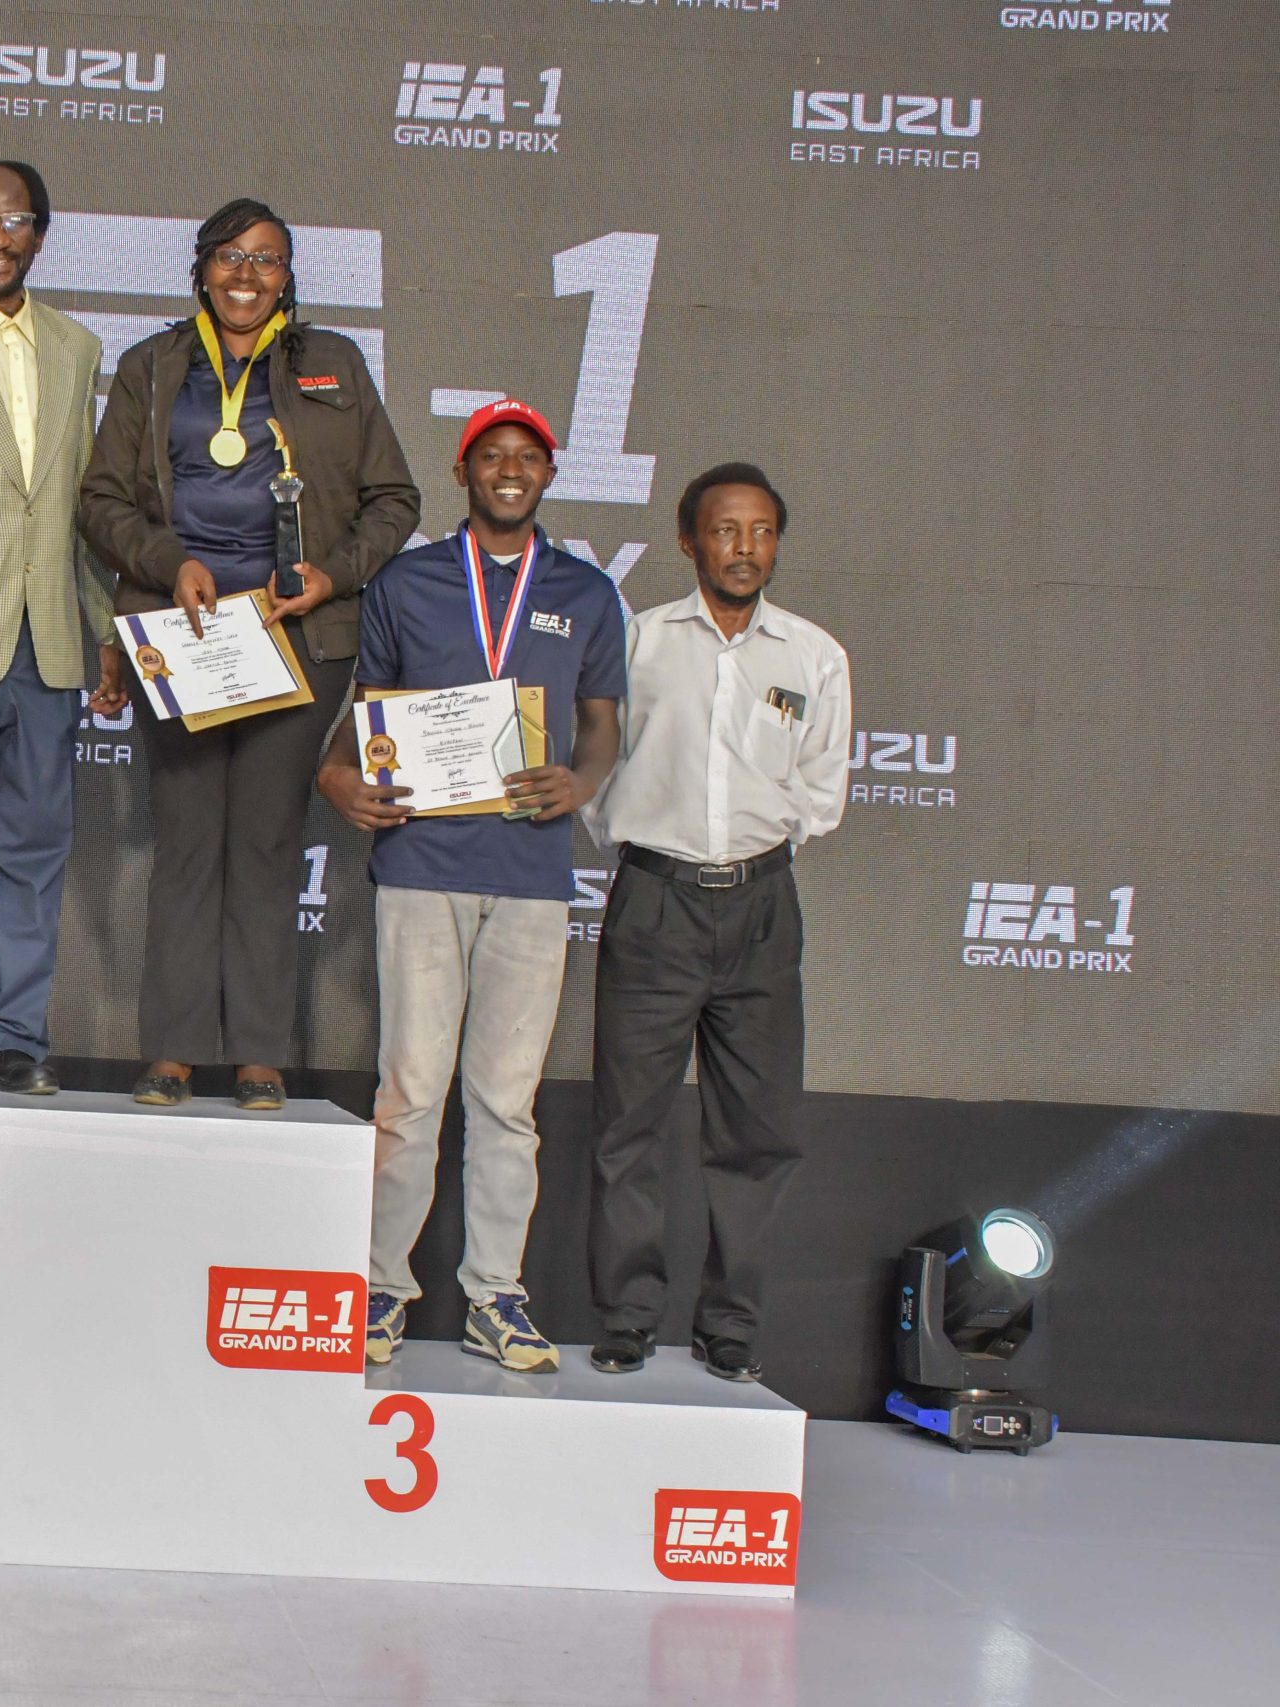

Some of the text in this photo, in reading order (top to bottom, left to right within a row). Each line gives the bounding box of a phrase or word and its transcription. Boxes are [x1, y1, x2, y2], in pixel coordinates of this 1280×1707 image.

[1000, 8, 1169, 33] GRAND PRIX
[61, 100, 163, 124] AFRICA
[792, 90, 982, 137] ISUZU
[394, 124, 559, 153] GRAND PRIX
[790, 143, 981, 170] EAST AFRICA
[530, 611, 571, 633] IEA-1
[530, 624, 570, 639] GRAND PRIX
[408, 694, 490, 715] Certificate of Excellence
[528, 690, 539, 701] 3
[852, 784, 956, 808] AFRICA
[962, 945, 1132, 973] GRAND PRIX
[219, 1333, 352, 1354] GRAND PRIX
[364, 1393, 439, 1513] 3
[665, 1549, 787, 1568] GRAND PRIX
